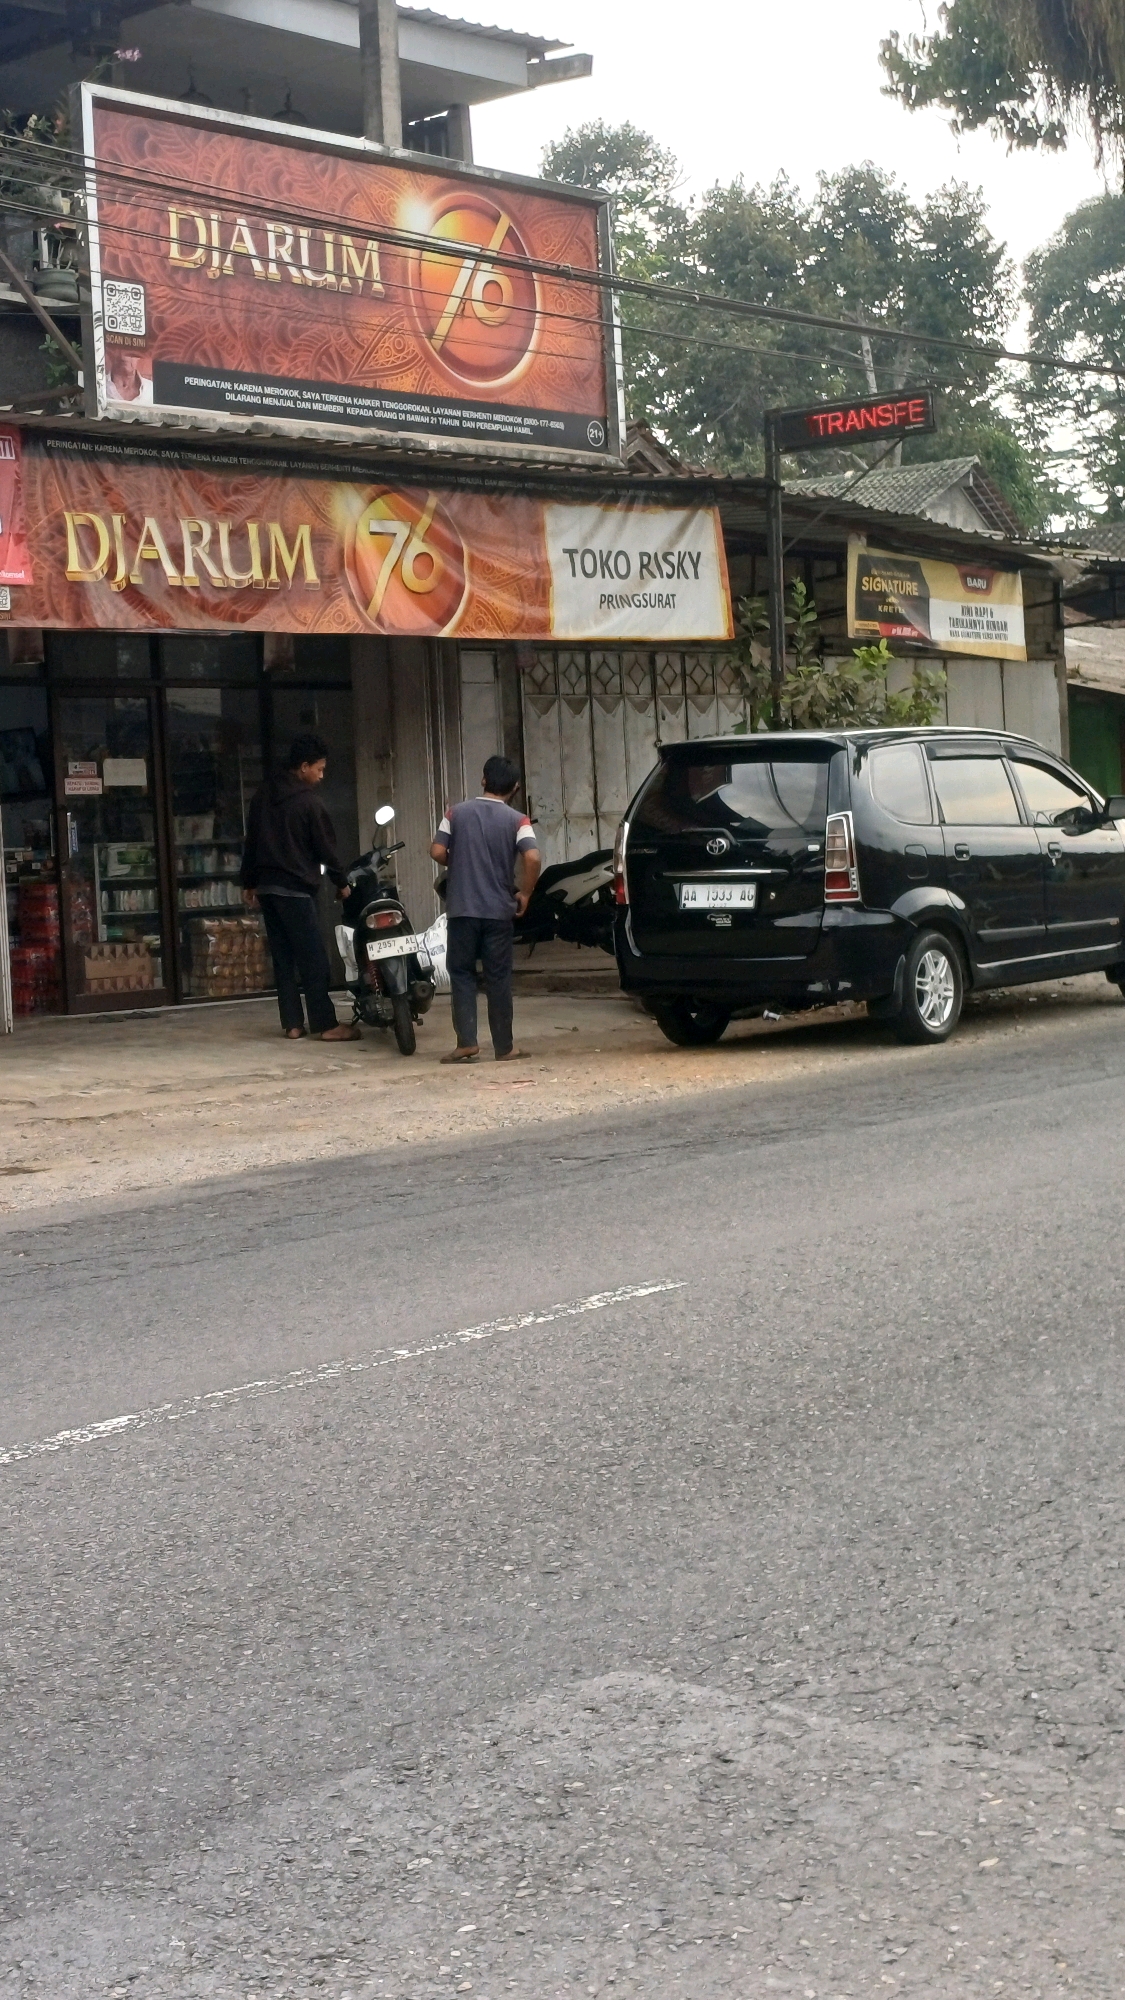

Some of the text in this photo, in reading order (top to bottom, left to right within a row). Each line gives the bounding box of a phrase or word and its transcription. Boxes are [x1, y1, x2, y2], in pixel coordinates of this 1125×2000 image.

[167, 206, 514, 352] DJARUM 76
[105, 334, 145, 347] SCAN DI SINI
[184, 376, 232, 390] PERINGATAN:
[234, 383, 263, 394] KARENA
[264, 386, 300, 399] MEROKOK,
[302, 391, 320, 401] SAYA
[321, 393, 352, 405] TERKENA
[353, 397, 380, 408] KANKER
[225, 392, 261, 404] DILARANG
[262, 397, 295, 408] MENJUAL
[296, 401, 311, 410] DAN
[312, 403, 344, 414] MEMBERI
[346, 406, 373, 418] KEPADA
[374, 409, 397, 420] ORANG
[398, 412, 406, 421] DI
[406, 414, 430, 425] BAWAH
[430, 416, 437, 425] 21
[438, 417, 460, 427] TAHUN
[462, 420, 476, 429] DAN
[476, 421, 512, 433] PEREMPUAN
[811, 400, 925, 436] TRANSFE
[589, 428, 603, 439] 21+
[46, 439, 94, 451] PERINGATAN:
[94, 444, 123, 454] KARENA
[161, 450, 180, 459] SAYA
[211, 455, 238, 464] KANKER
[63, 491, 443, 621] DJARUM 76
[562, 548, 702, 580] TOKO RISKY
[862, 577, 918, 596] SIGNATURE
[966, 577, 987, 589] BARU
[599, 593, 677, 609] PRINGSURAT
[683, 889, 696, 901] AA
